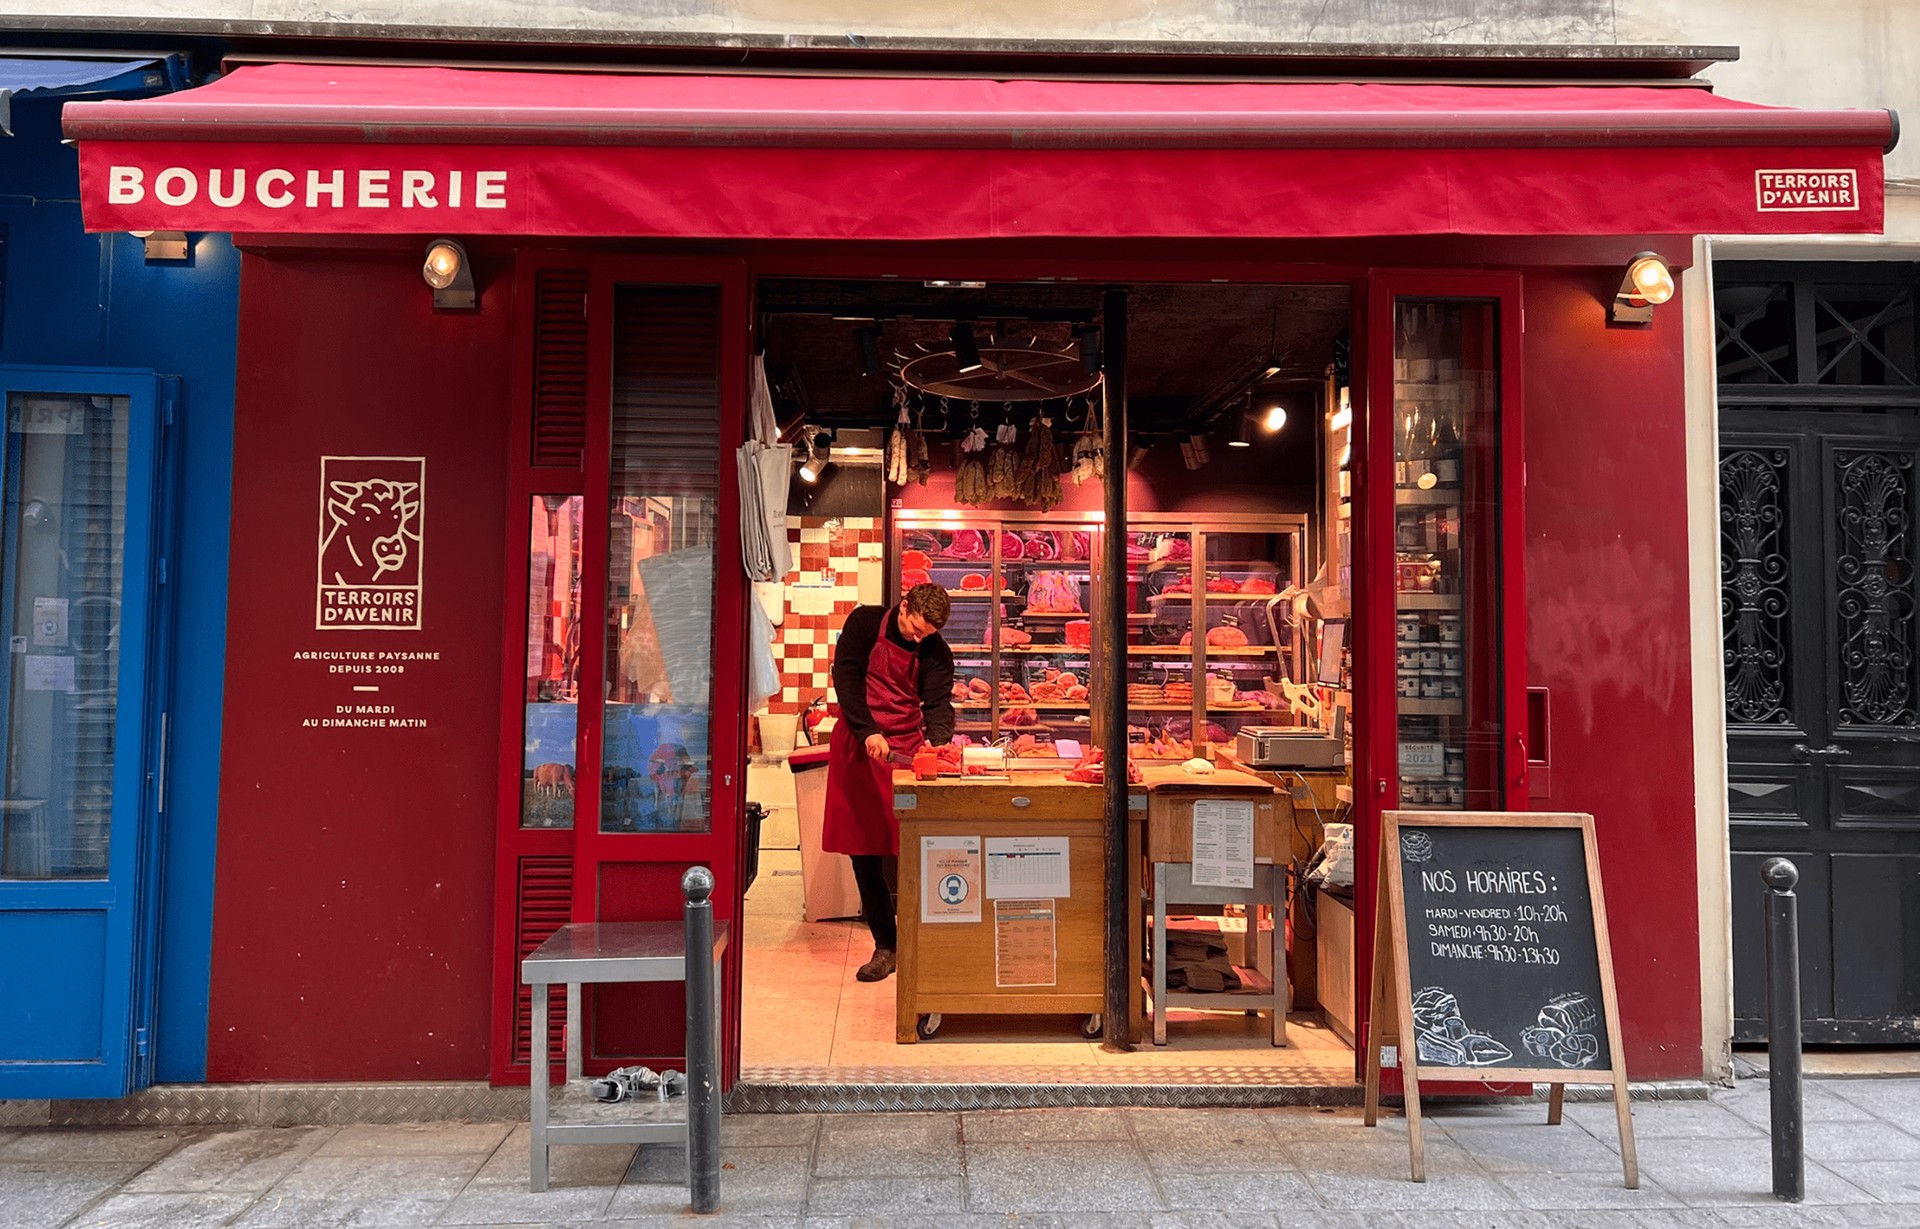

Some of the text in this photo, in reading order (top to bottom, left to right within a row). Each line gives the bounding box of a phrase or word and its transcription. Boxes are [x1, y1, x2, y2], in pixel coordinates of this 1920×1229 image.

[108, 166, 508, 209] BOUCHERIE
[1762, 174, 1850, 188] TERROIRS
[1763, 190, 1851, 204] D'AVENIR
[324, 591, 415, 606] TERROIRS
[324, 607, 414, 622] D'AVENIR
[293, 651, 440, 661] AGRICULTURE PAYSANNE
[329, 665, 405, 674] DEPUIS 2008
[336, 705, 395, 714] DU MARDI
[302, 718, 427, 728] AU DIMANCHE MATIN
[1405, 753, 1435, 763] 2021
[1421, 869, 1457, 894] NOS
